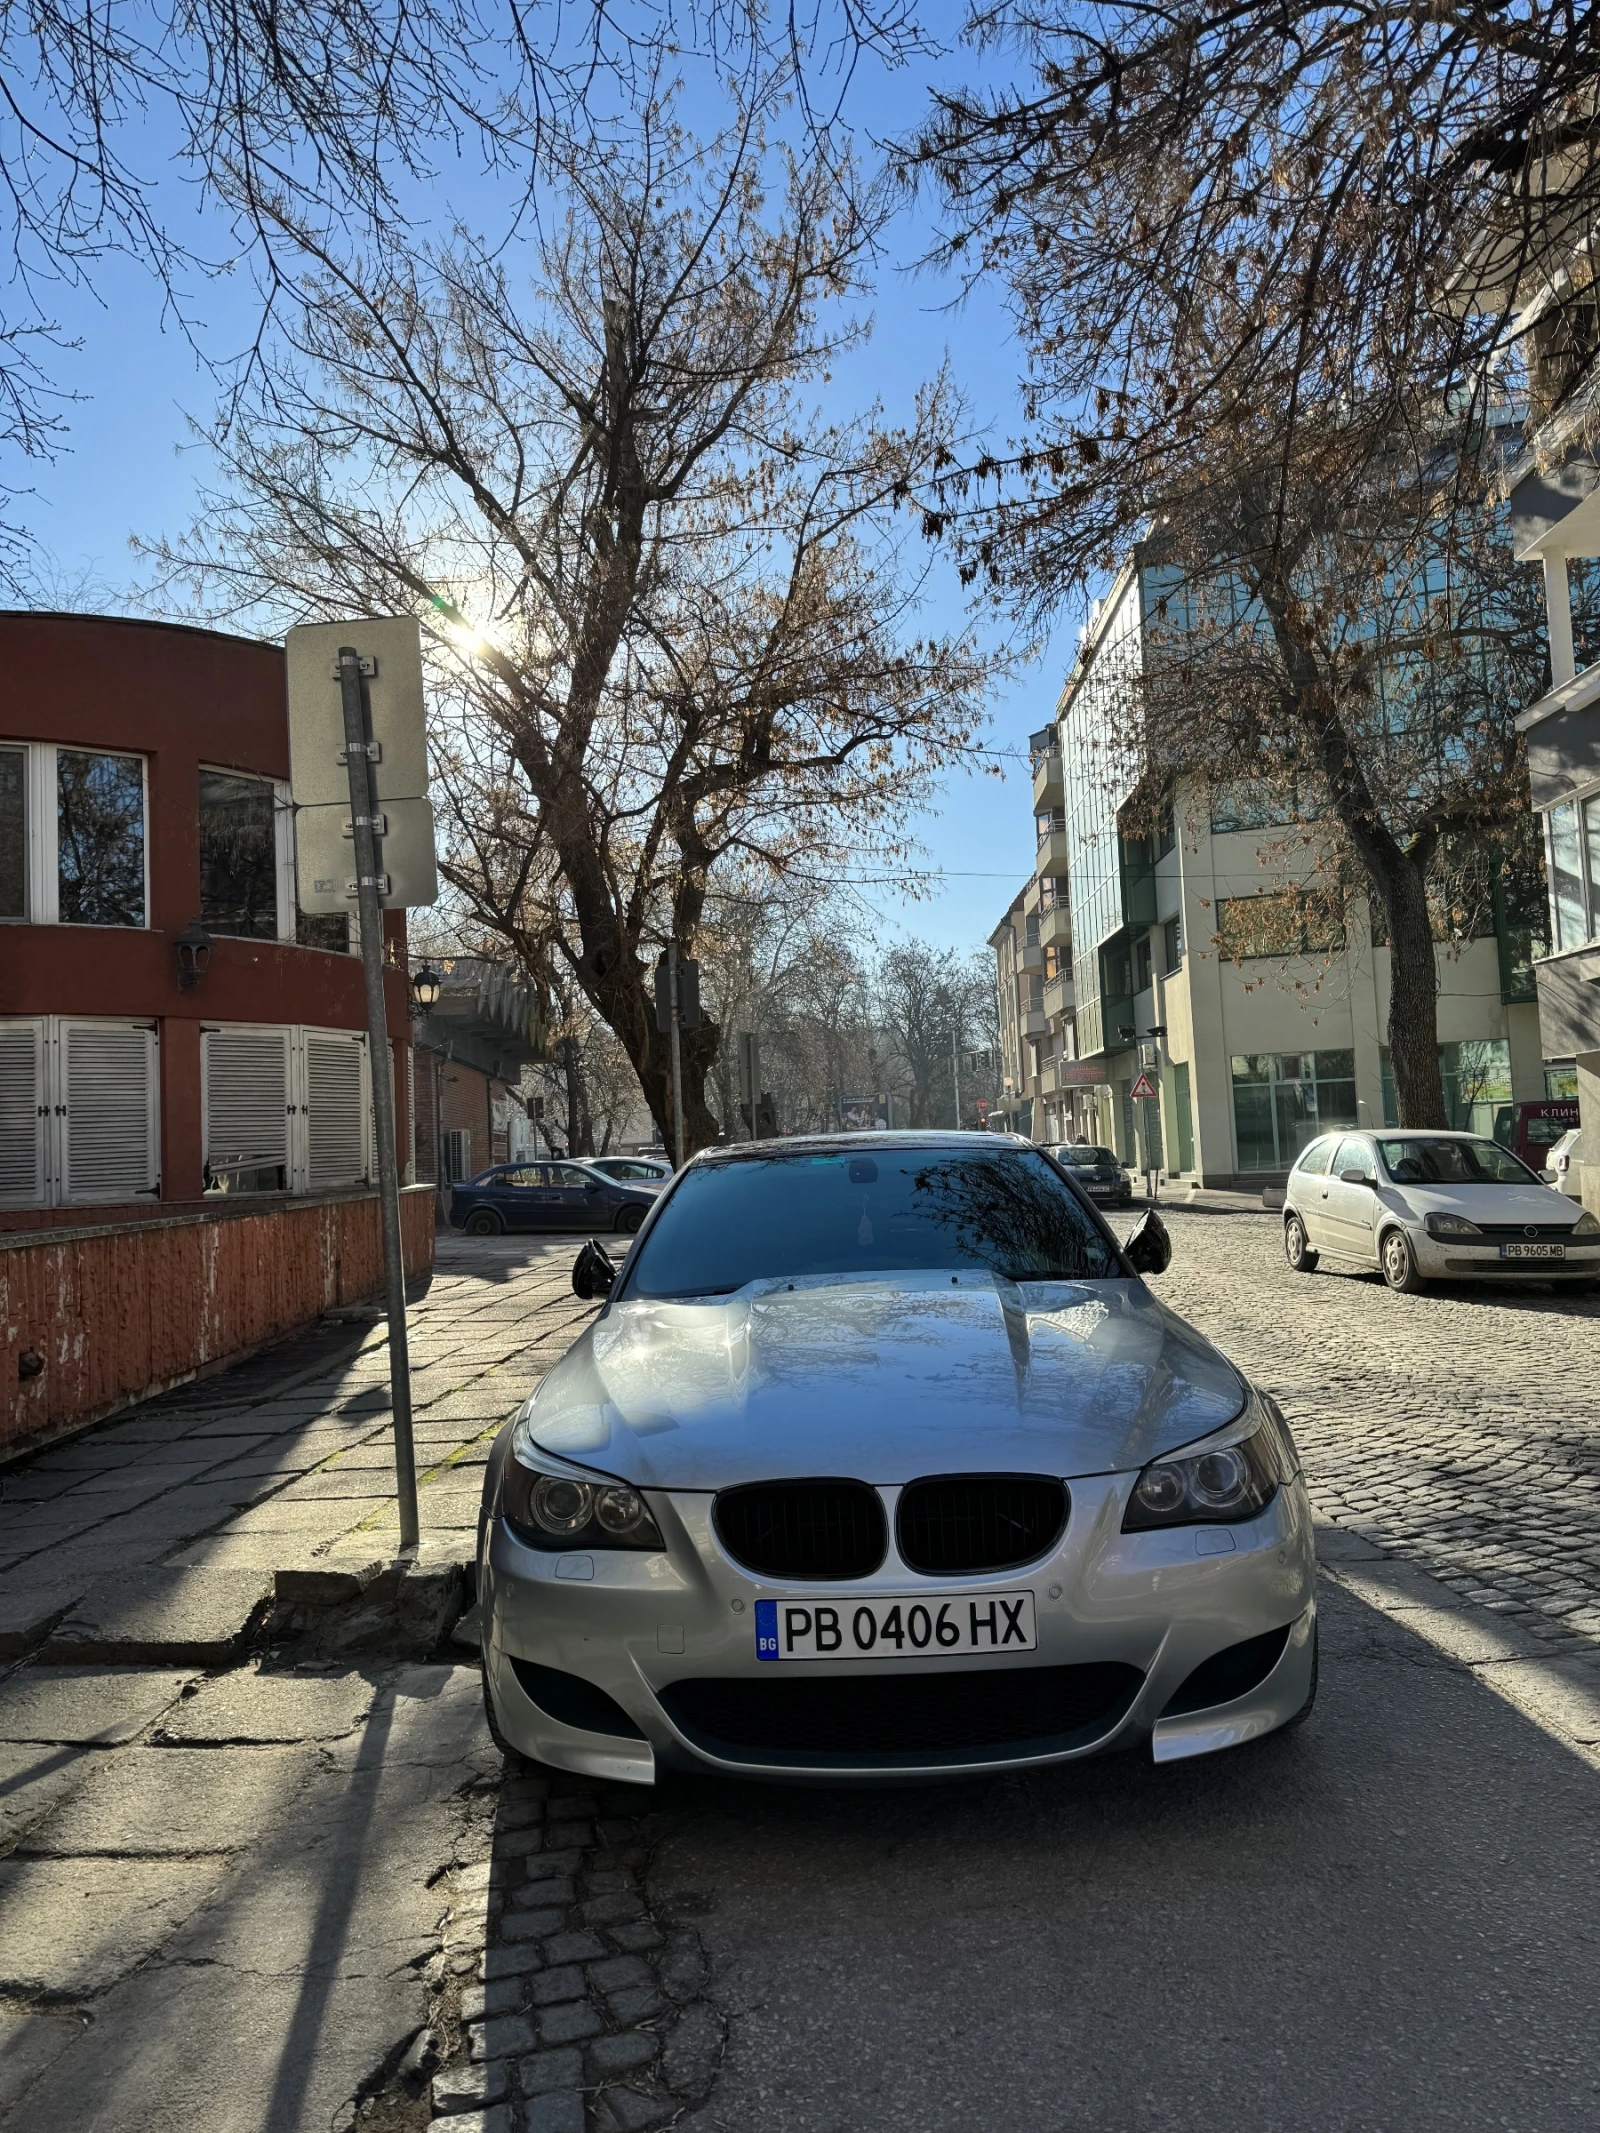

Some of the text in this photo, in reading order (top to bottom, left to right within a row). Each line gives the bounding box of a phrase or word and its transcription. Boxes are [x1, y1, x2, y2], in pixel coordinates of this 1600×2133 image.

[1541, 1108, 1579, 1117] КЛИН
[1508, 1245, 1522, 1256] PB
[1523, 1245, 1549, 1256] 9605
[1550, 1245, 1563, 1256] MB
[785, 1599, 1027, 1652] PB 0406 HX
[759, 1637, 777, 1651] BG
